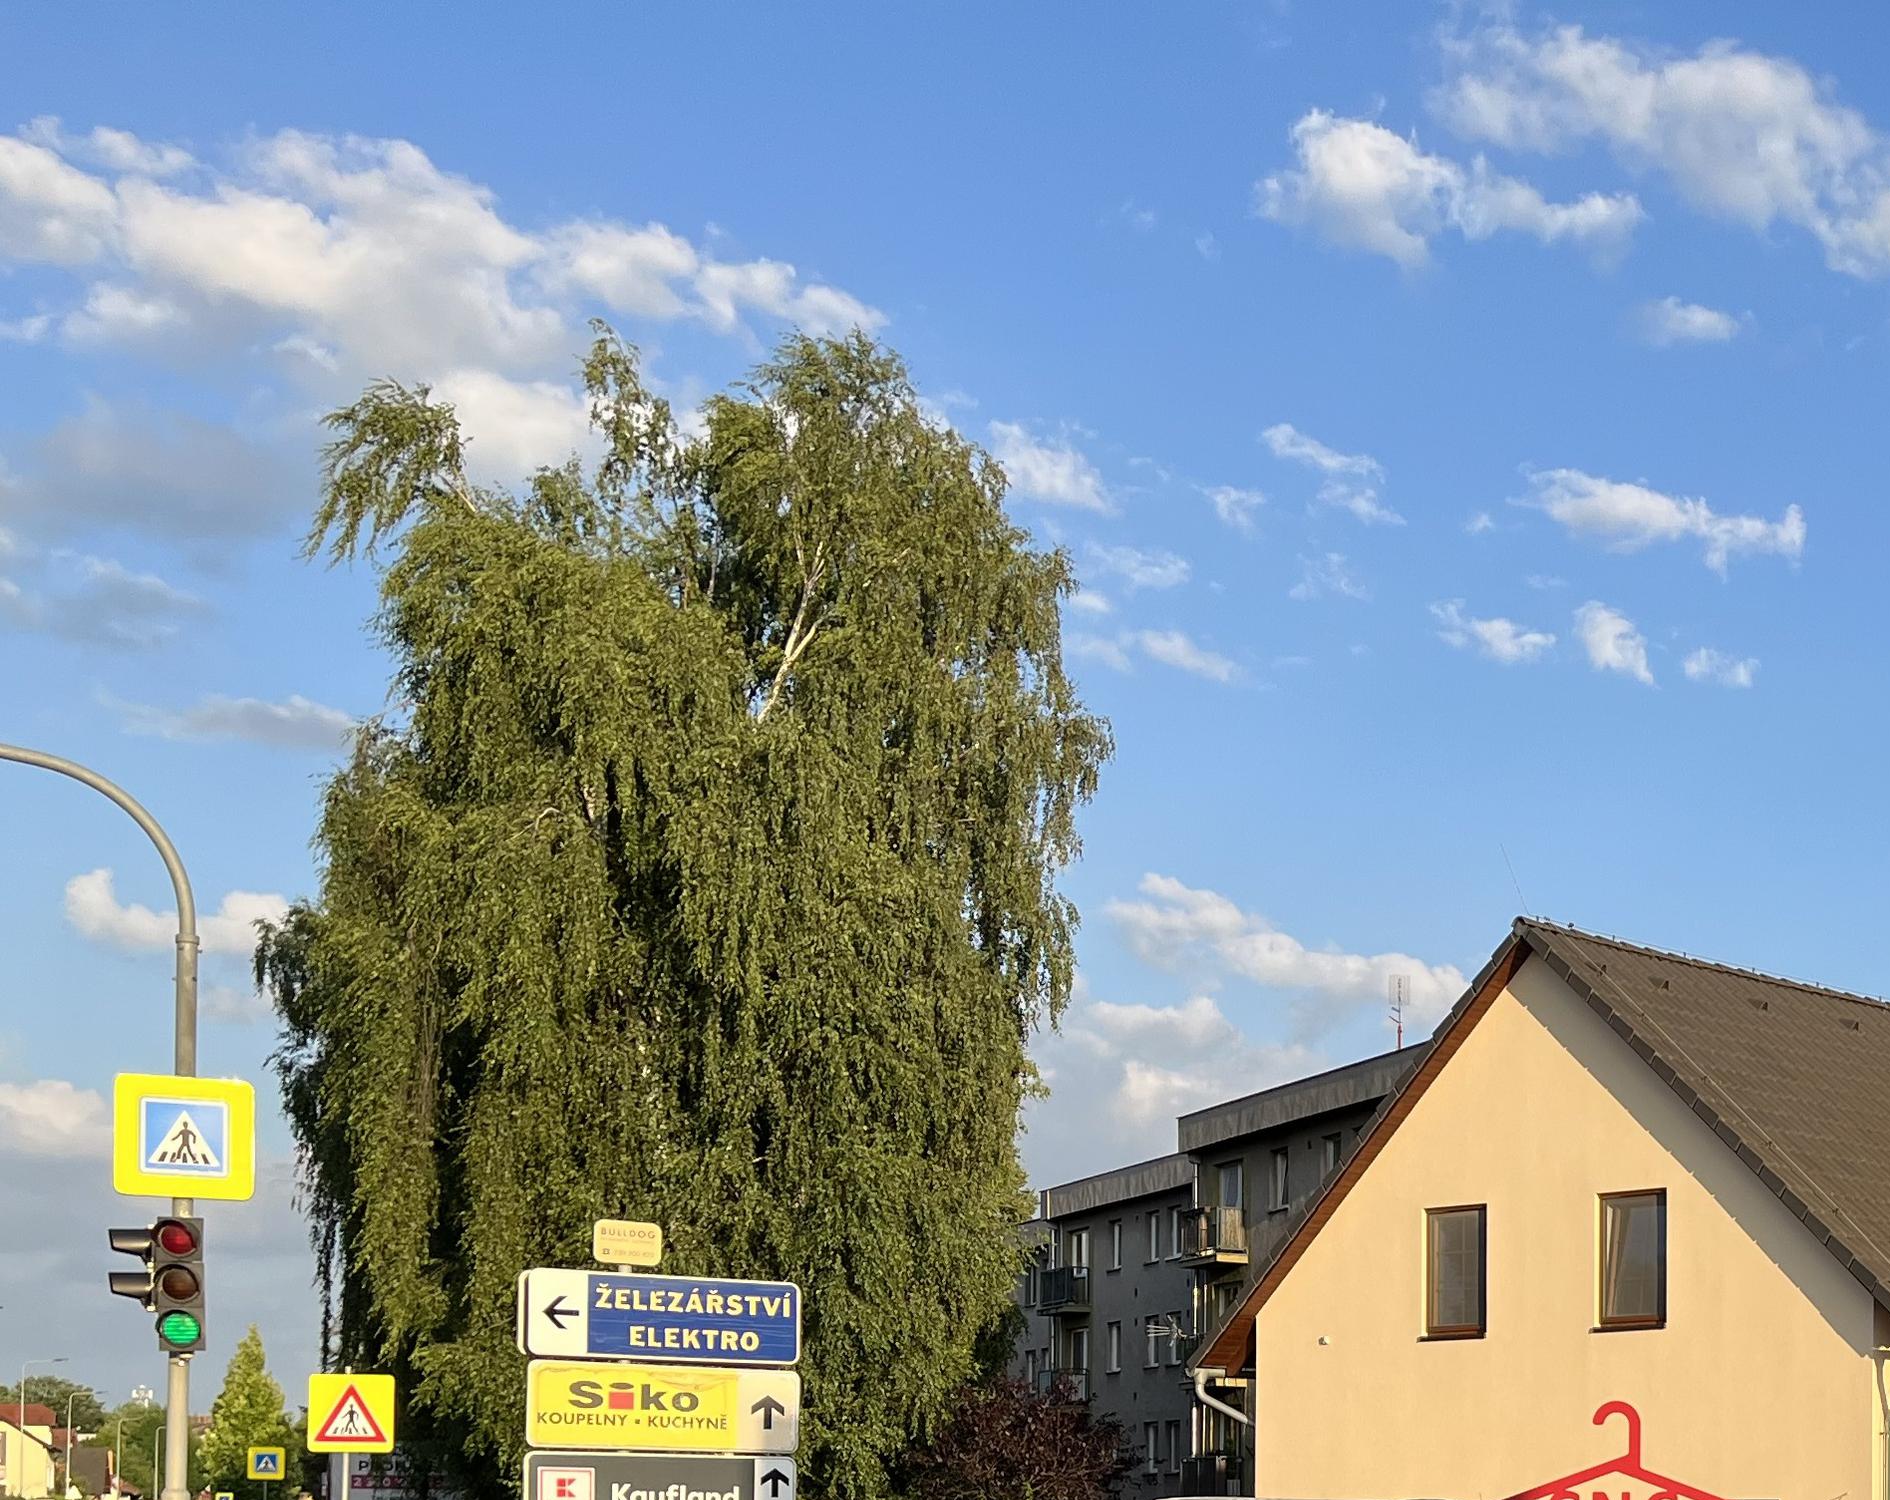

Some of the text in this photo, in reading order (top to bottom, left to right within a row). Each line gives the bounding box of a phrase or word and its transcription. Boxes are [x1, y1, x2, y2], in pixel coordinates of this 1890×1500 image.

[601, 1226, 656, 1239] BULLDOG
[594, 1283, 791, 1318] ŽELEZÁŘSTVÍ
[629, 1326, 760, 1351] ELEKTRO
[537, 1412, 728, 1430] KOUPELNY KUCHYNĚ
